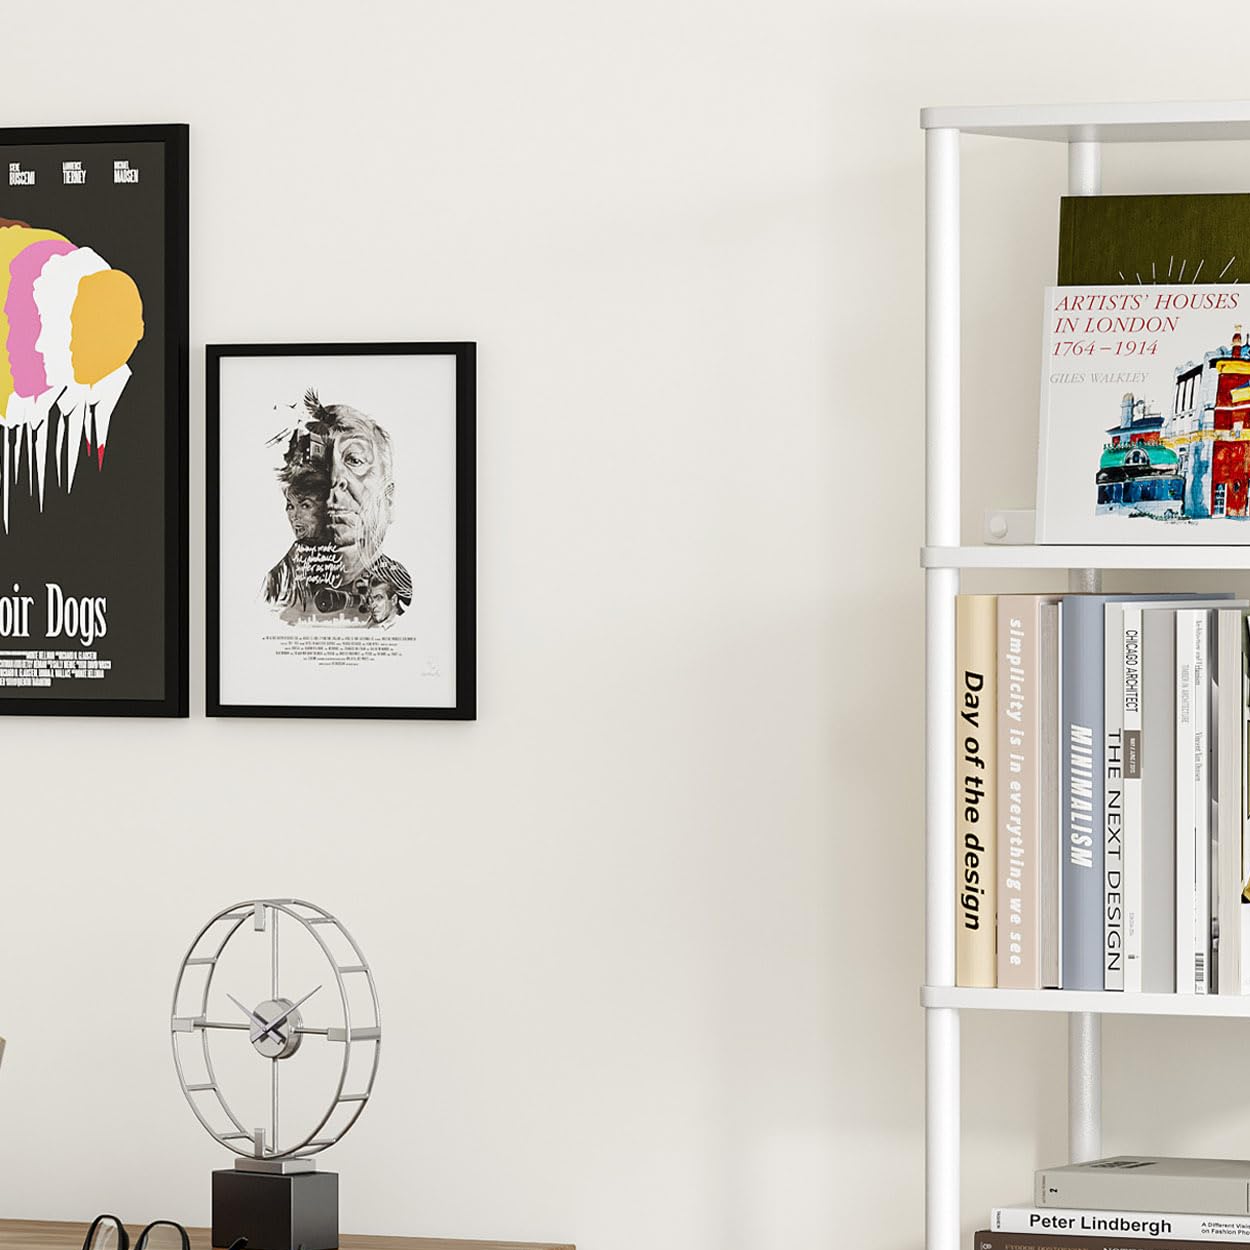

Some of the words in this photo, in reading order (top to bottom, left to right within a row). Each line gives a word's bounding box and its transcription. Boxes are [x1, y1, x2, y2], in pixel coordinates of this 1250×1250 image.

[1154, 292, 1240, 310] HOUSES
[1054, 318, 1080, 334] IN
[1084, 316, 1180, 334] LONDON
[1050, 372, 1085, 385] GILES
[1091, 372, 1149, 384] WALKLEY
[45, 583, 107, 647] Dogs
[1125, 629, 1138, 666] CHICAGO
[1006, 618, 1025, 722] simplicity
[960, 670, 985, 728] Day
[1125, 667, 1138, 713] ARCHITECT
[964, 737, 985, 769] of
[1009, 728, 1025, 746] is
[1107, 728, 1122, 779] THE
[1009, 753, 1025, 773] in
[964, 784, 985, 823] the
[1070, 723, 1093, 868] MINIMALISM
[1006, 780, 1025, 890] everything
[1107, 789, 1122, 861] NEXT
[960, 832, 985, 931] design
[1009, 897, 1023, 925] we
[1107, 870, 1122, 972] DESIGN
[1009, 931, 1023, 966] see
[1029, 1213, 1076, 1229] Peter
[1081, 1216, 1172, 1236] Lindbergh
